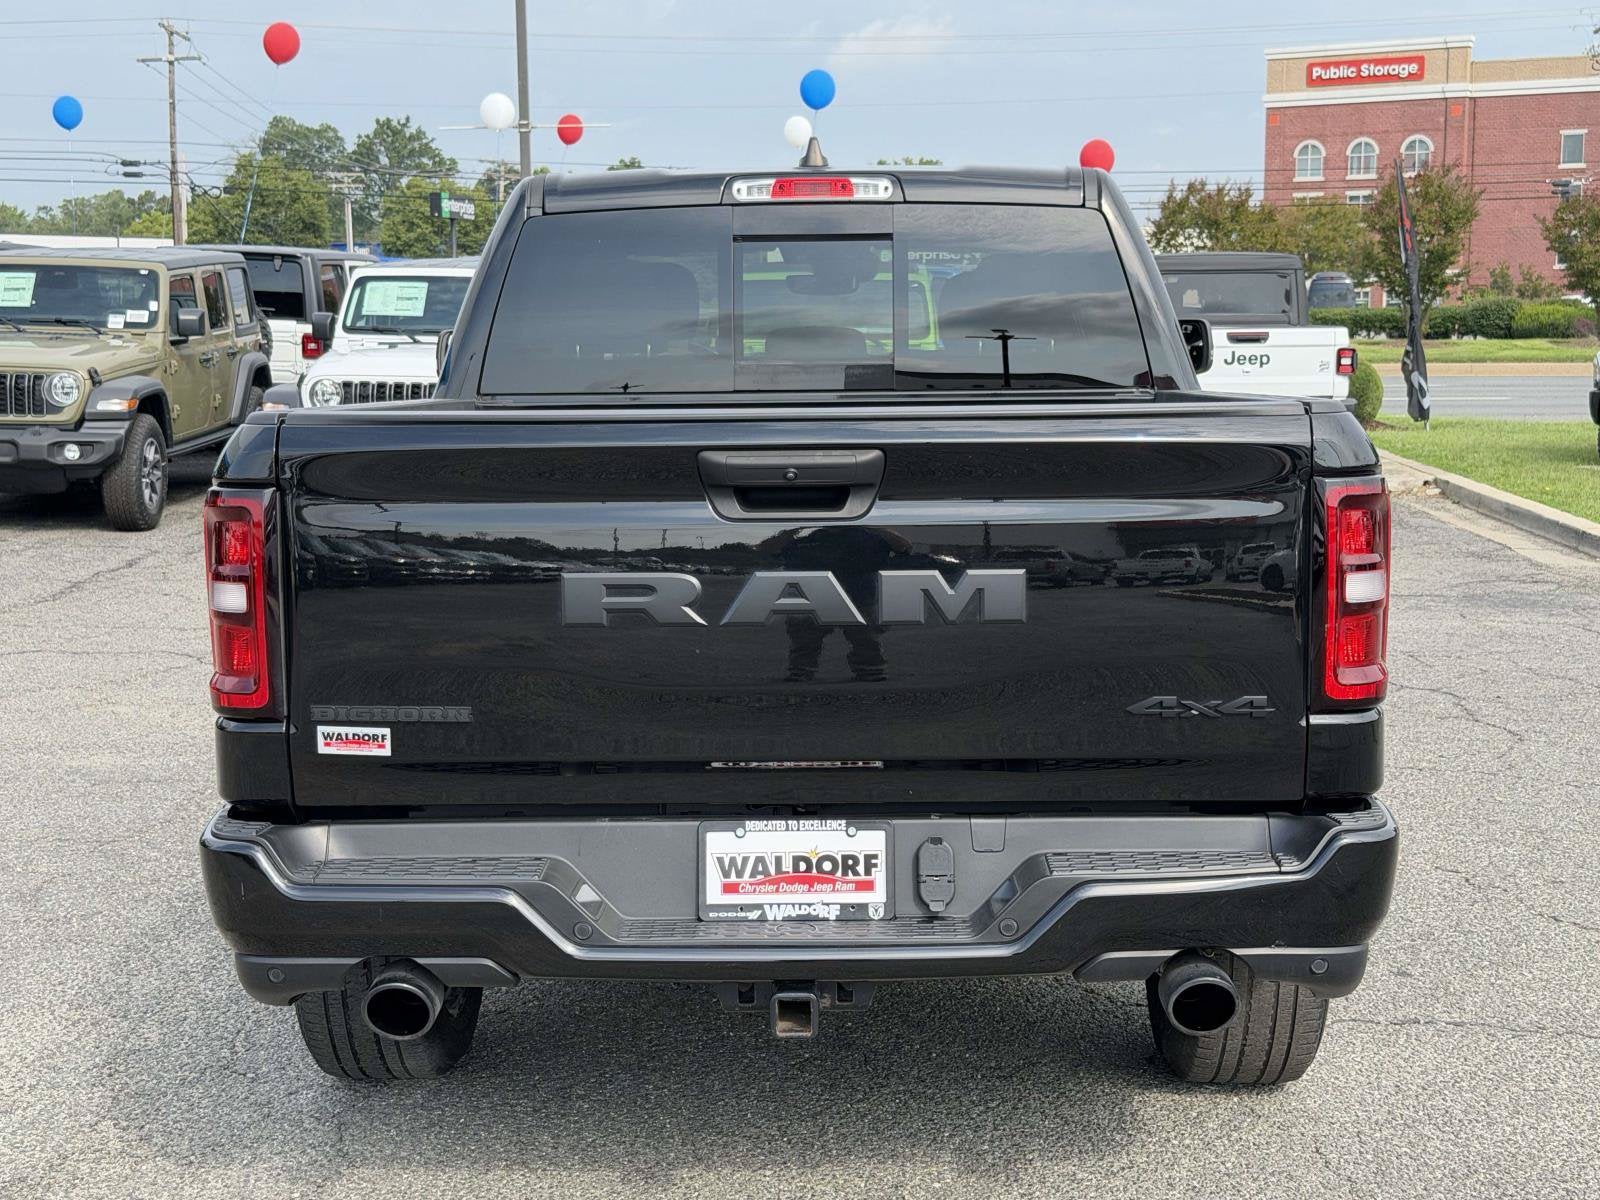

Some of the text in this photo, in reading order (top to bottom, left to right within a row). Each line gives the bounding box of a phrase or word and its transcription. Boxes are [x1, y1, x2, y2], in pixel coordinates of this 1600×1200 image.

[1311, 63, 1418, 80] Public Storage
[1223, 350, 1271, 368] Jeep
[560, 569, 1027, 626] RAM
[1125, 695, 1277, 718] 4x4
[321, 731, 388, 743] WALDORF
[745, 819, 847, 831] DEDICATED TO EXCELLENCE
[714, 852, 880, 880] WALDORF
[738, 881, 856, 894] Chrysler Dodge Jeep Ram
[763, 903, 841, 921] WALDORF
